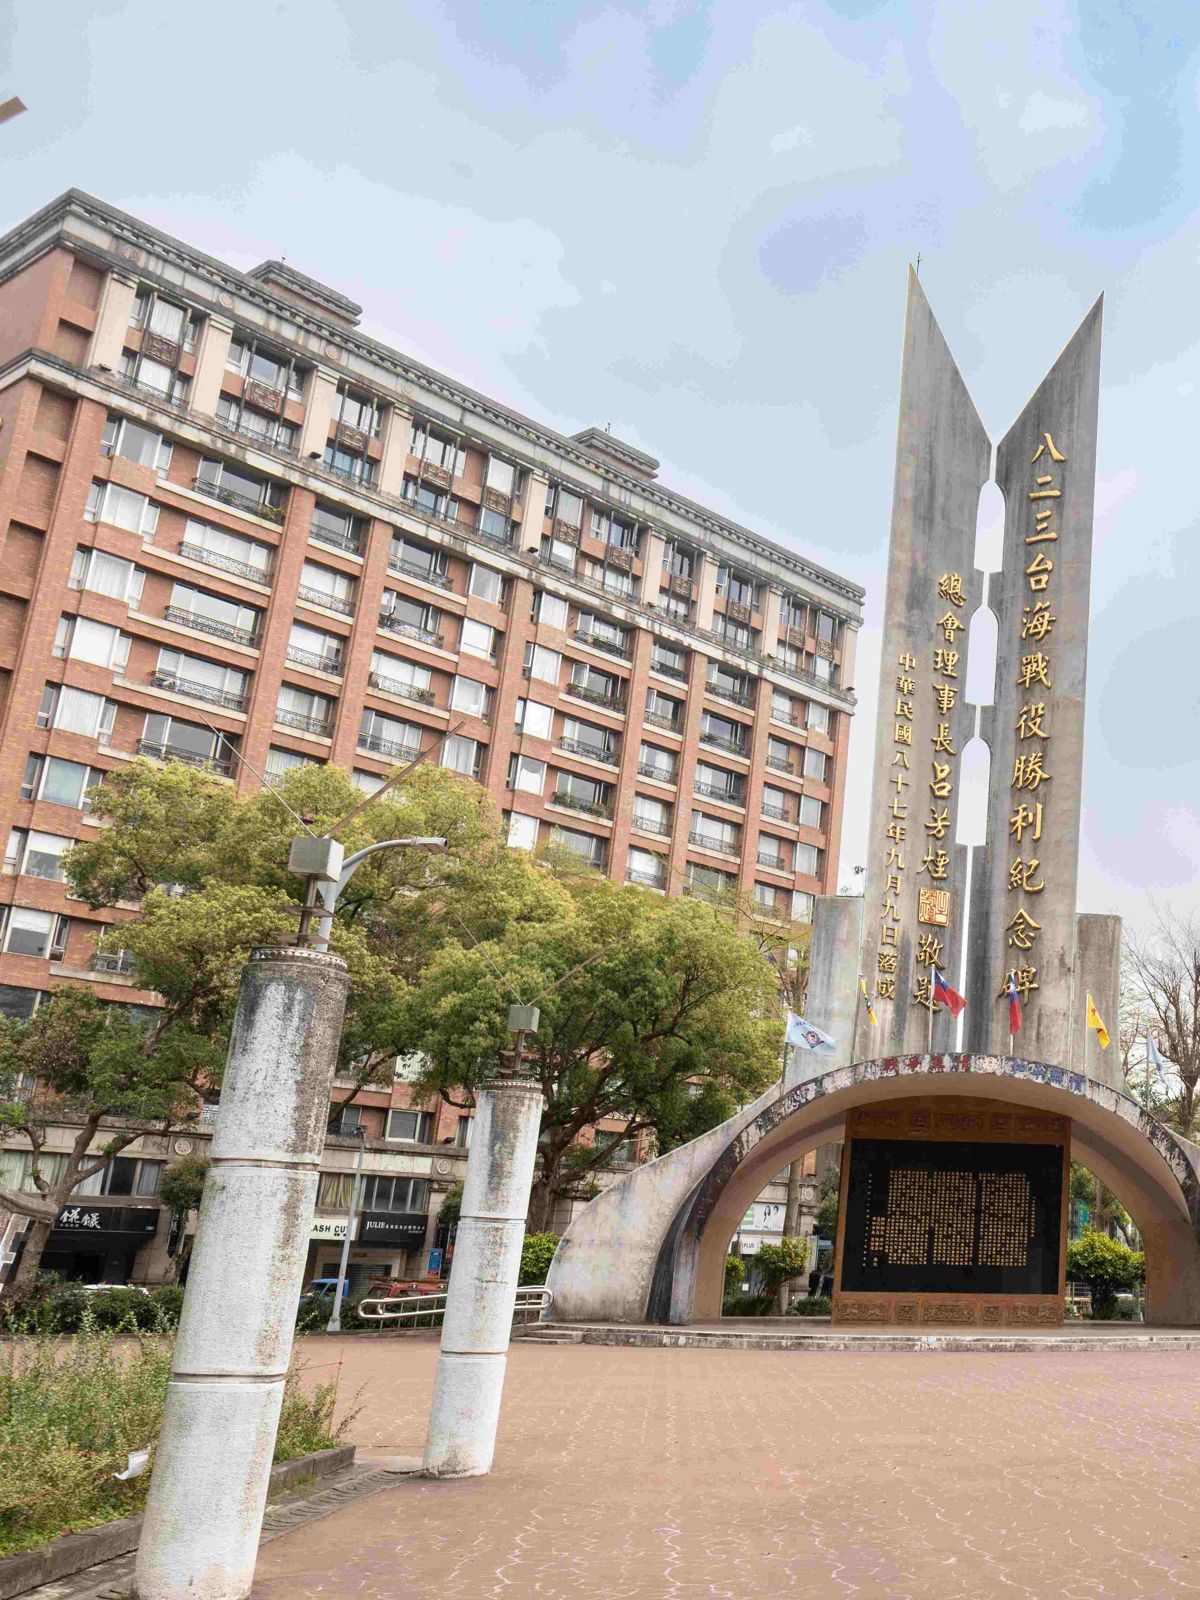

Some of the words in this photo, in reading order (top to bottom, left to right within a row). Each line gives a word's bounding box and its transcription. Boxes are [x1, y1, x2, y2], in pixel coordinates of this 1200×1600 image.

[1000, 433, 1066, 1006] 八二三台海戰役勝利紀念碑
[876, 652, 917, 1001] 中華民國八十七年九月九日落成
[311, 1224, 331, 1233] ASH
[366, 1221, 386, 1230] JULIE
